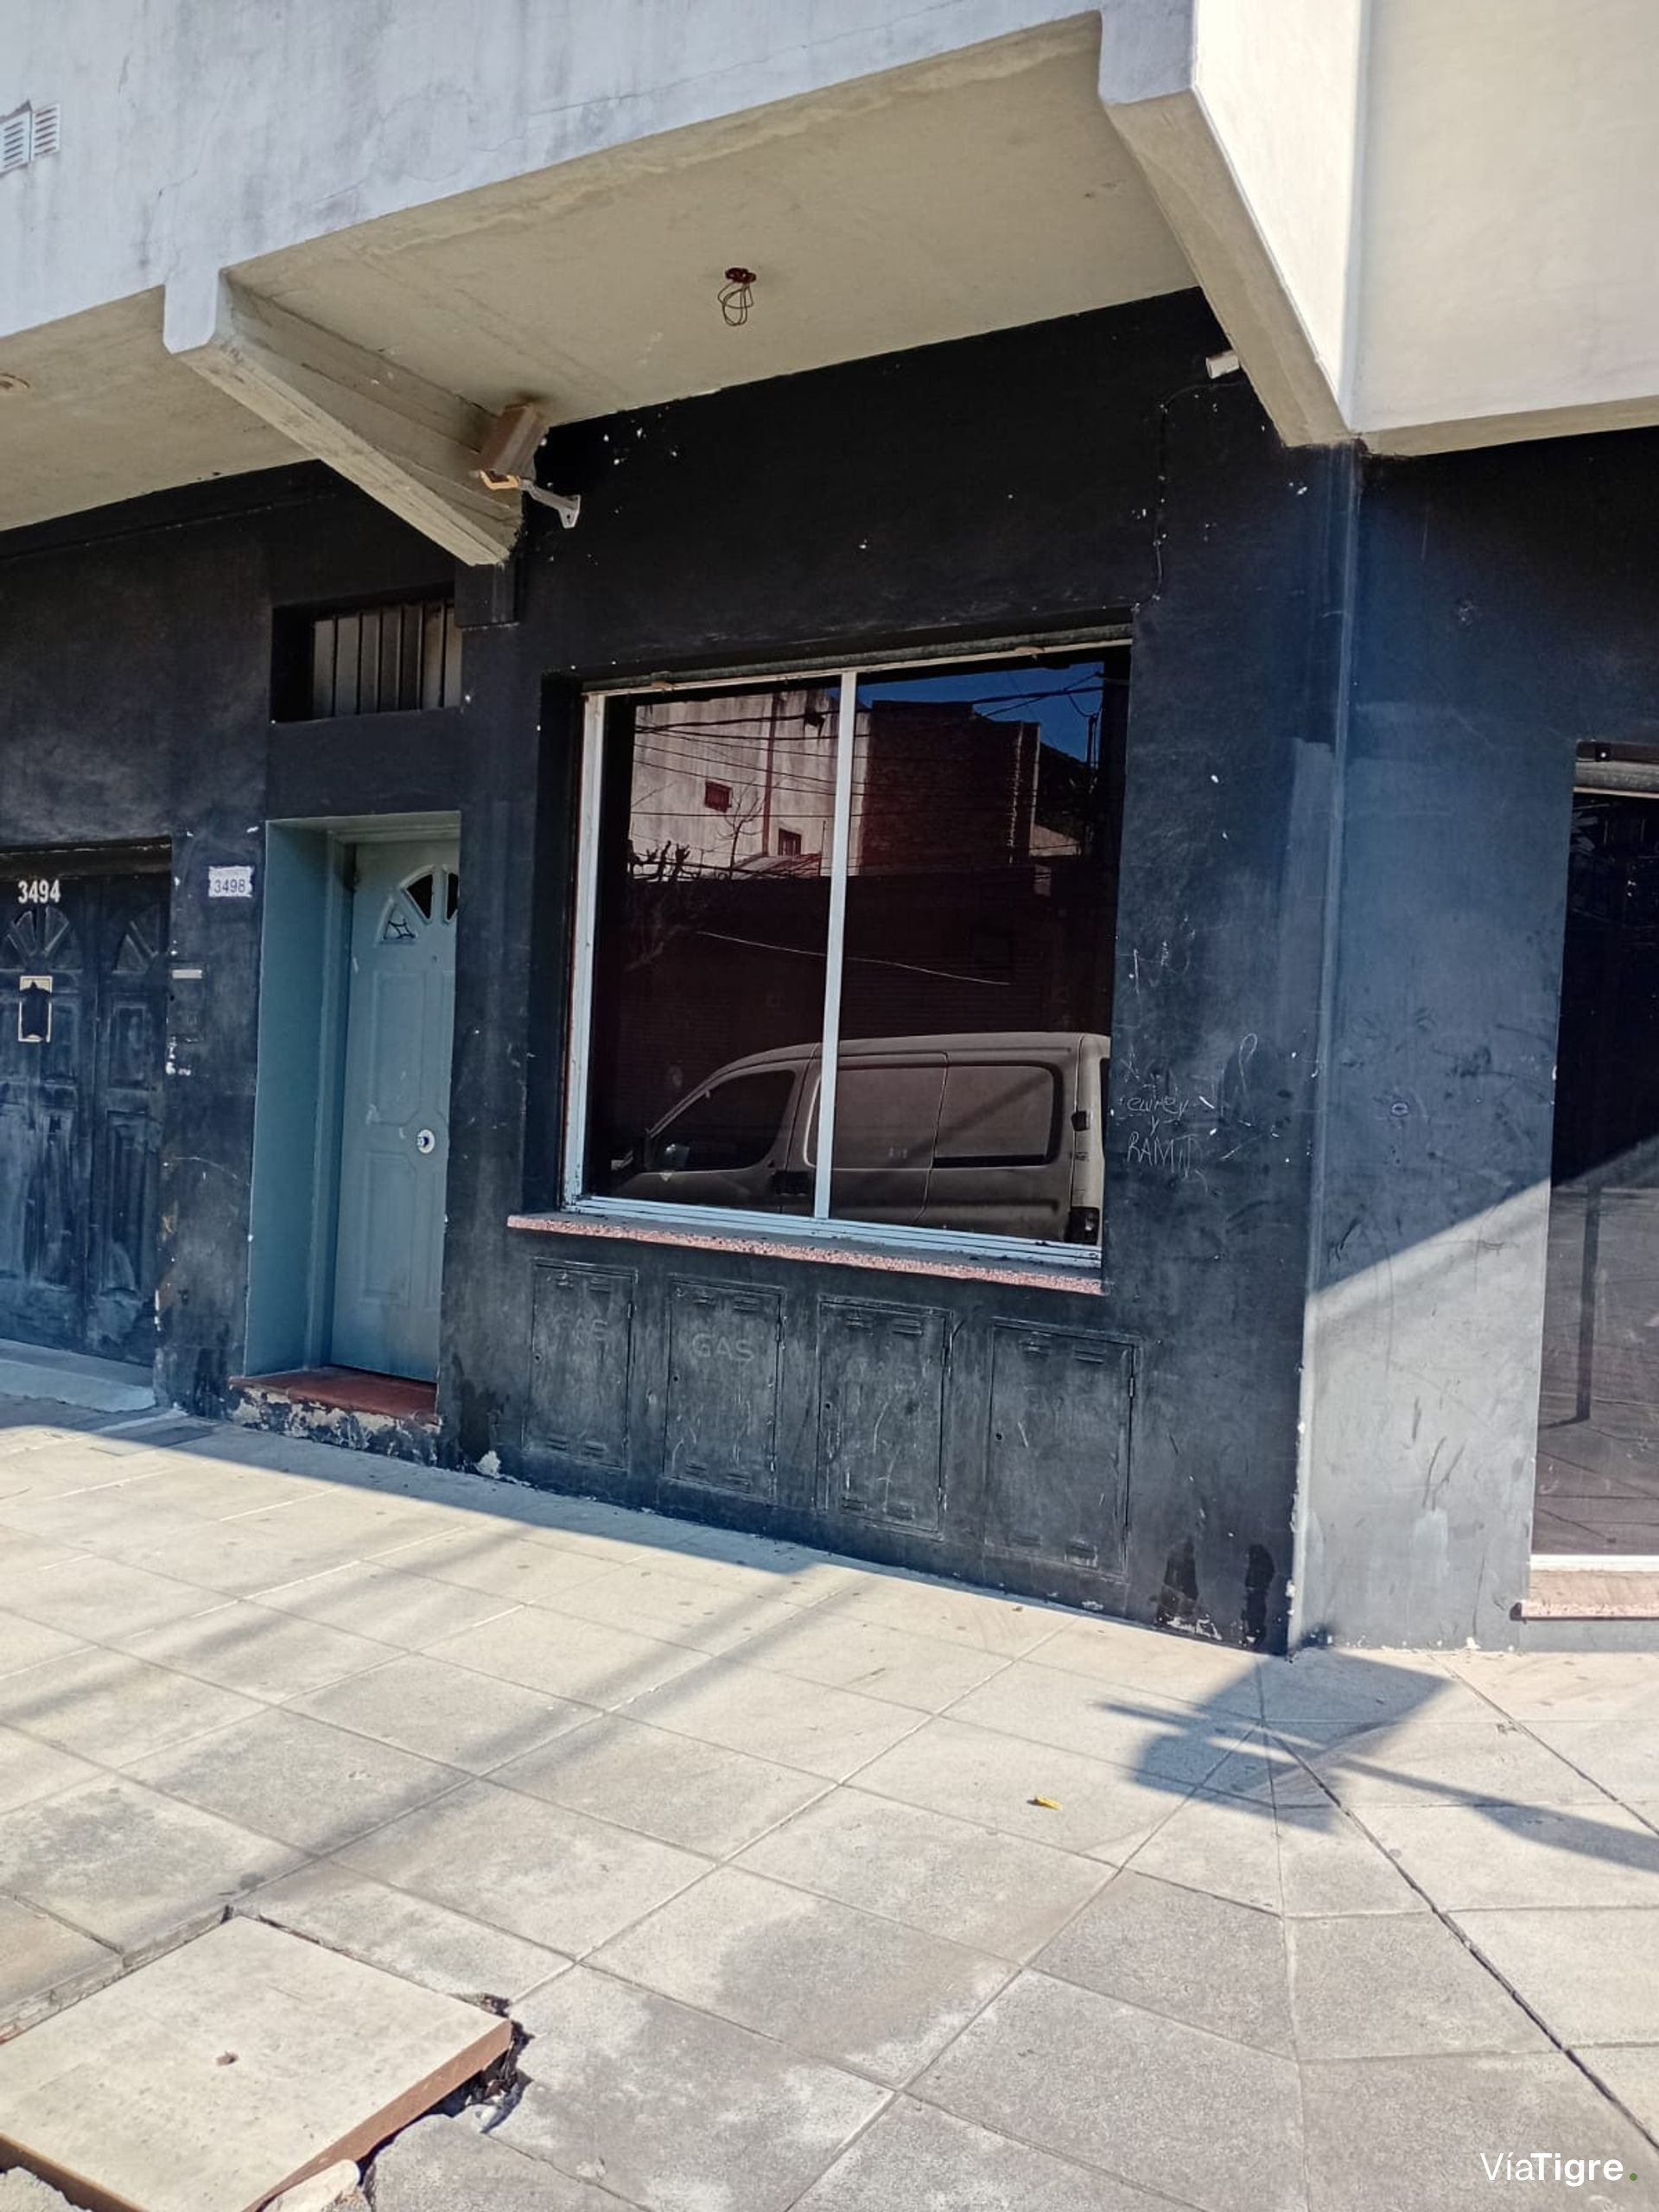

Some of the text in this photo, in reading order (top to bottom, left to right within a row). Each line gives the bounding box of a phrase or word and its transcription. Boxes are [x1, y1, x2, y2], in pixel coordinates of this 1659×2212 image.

[17, 879, 61, 904] 3494
[214, 878, 246, 893] 3498
[692, 1332, 754, 1362] GAS
